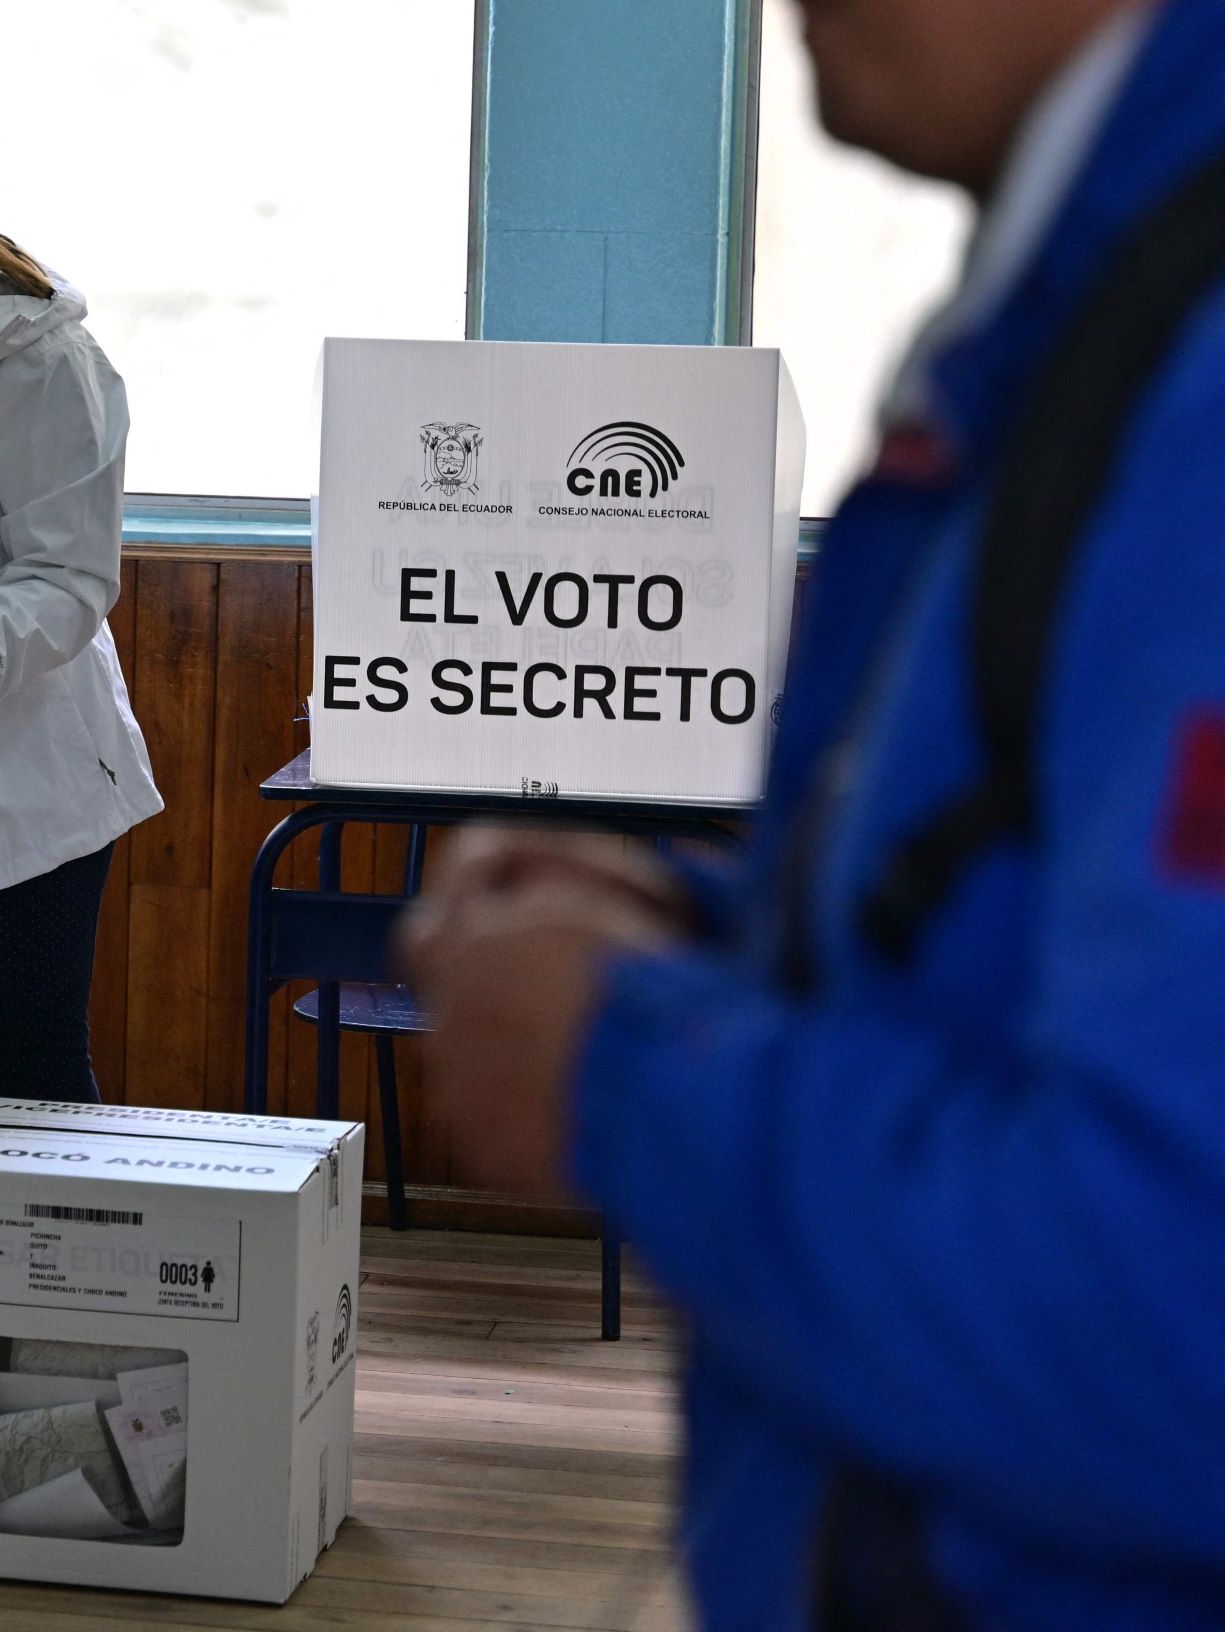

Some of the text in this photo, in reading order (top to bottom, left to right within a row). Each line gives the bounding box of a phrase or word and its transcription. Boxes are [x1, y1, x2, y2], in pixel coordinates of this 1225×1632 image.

[566, 468, 643, 498] CNE
[378, 500, 513, 514] REPÚBLICA DEL ECUADOR
[538, 505, 710, 519] CONSEJO NACIONAL ELECTORAL
[400, 567, 683, 631] EL VOTO
[323, 655, 409, 713] ES
[430, 658, 756, 725] SECRETO
[104, 1156, 275, 1175] ANDINO
[30, 1231, 61, 1241] PICHINCHA
[159, 1261, 198, 1287] 0003
